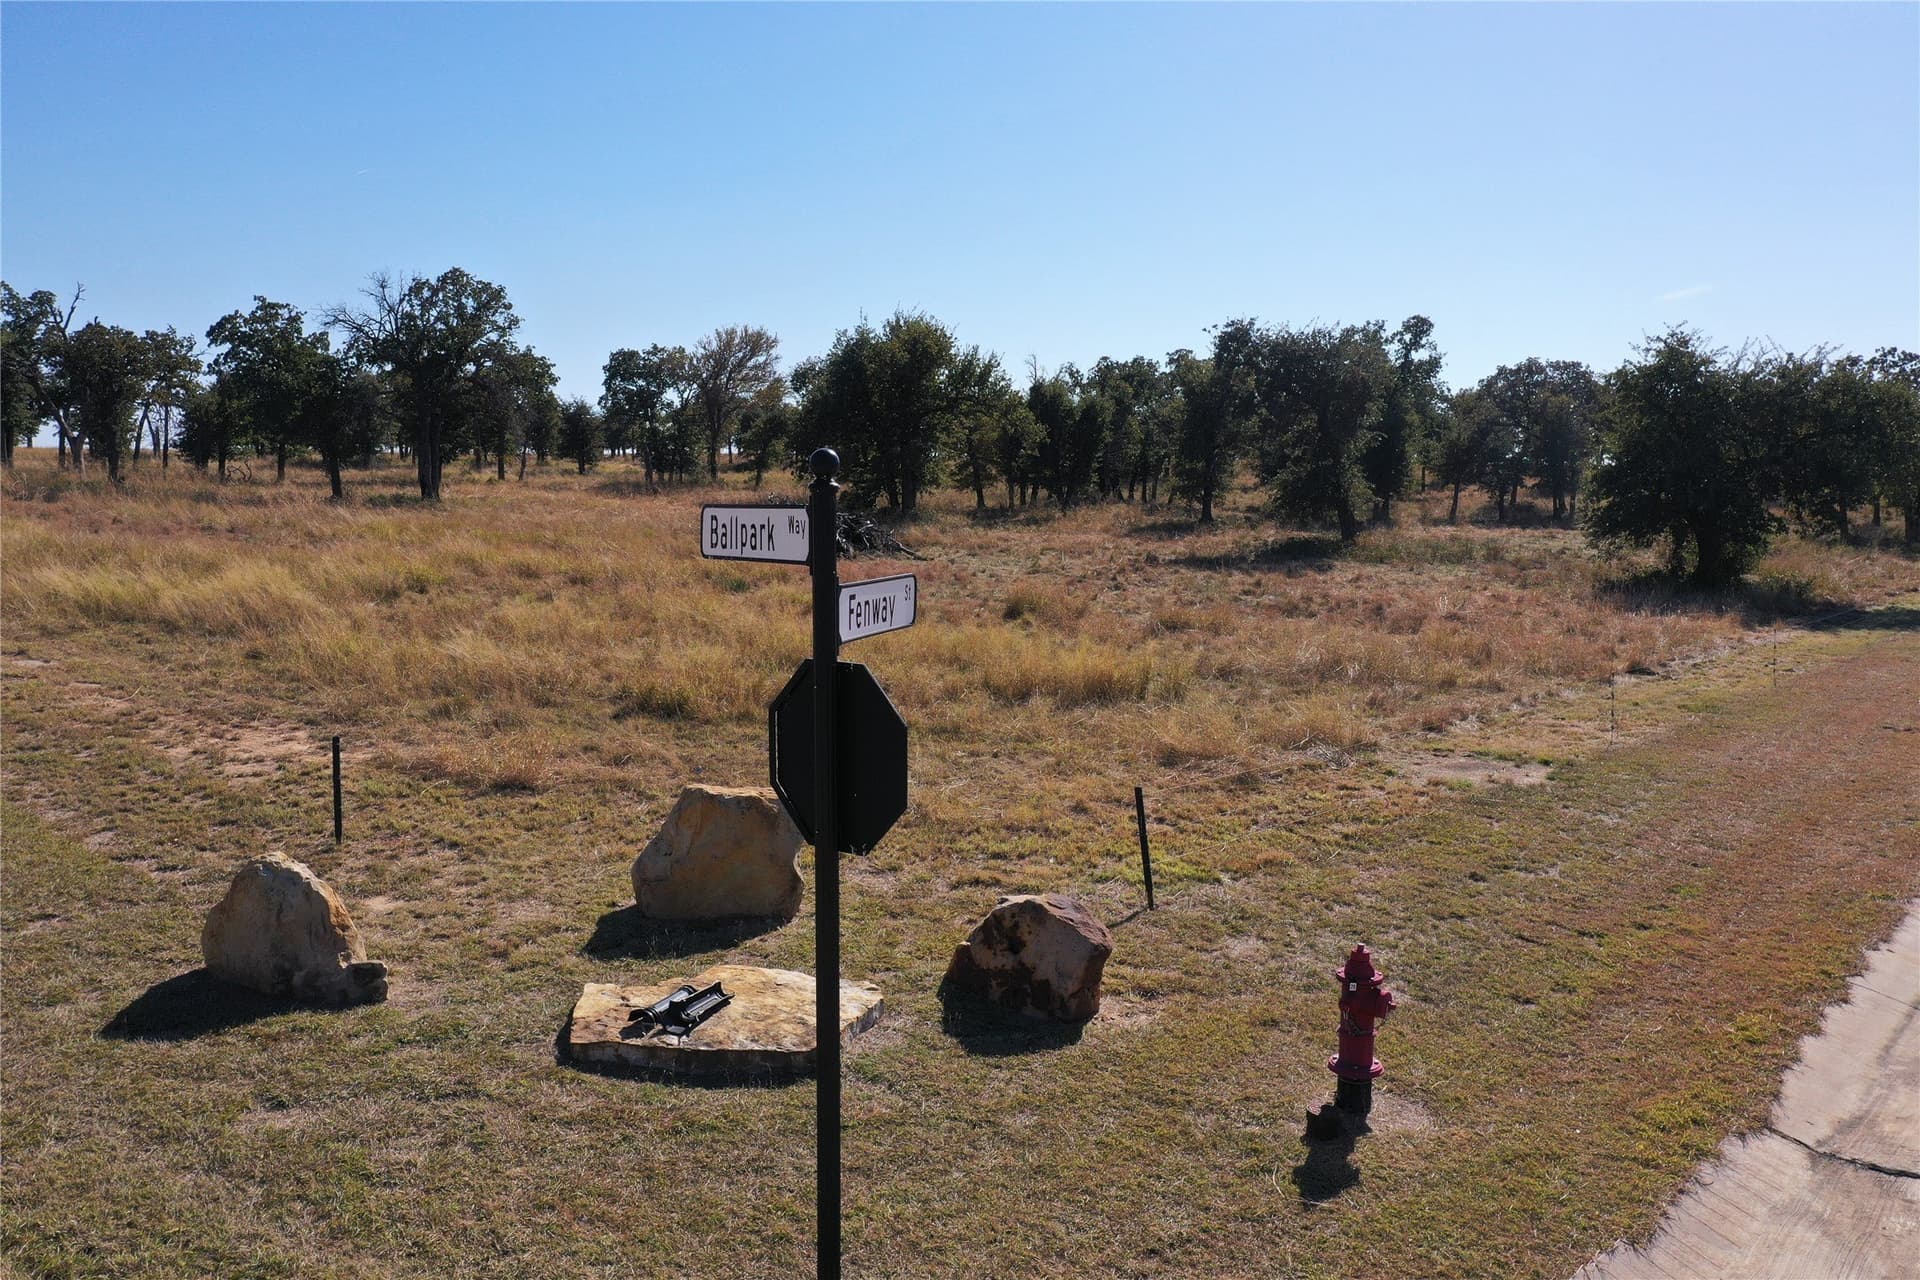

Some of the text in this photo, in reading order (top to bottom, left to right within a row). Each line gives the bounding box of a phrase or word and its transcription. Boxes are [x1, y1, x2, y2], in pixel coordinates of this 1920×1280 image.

[710, 514, 806, 556] Ballpark Way
[848, 583, 912, 631] Fenway St
